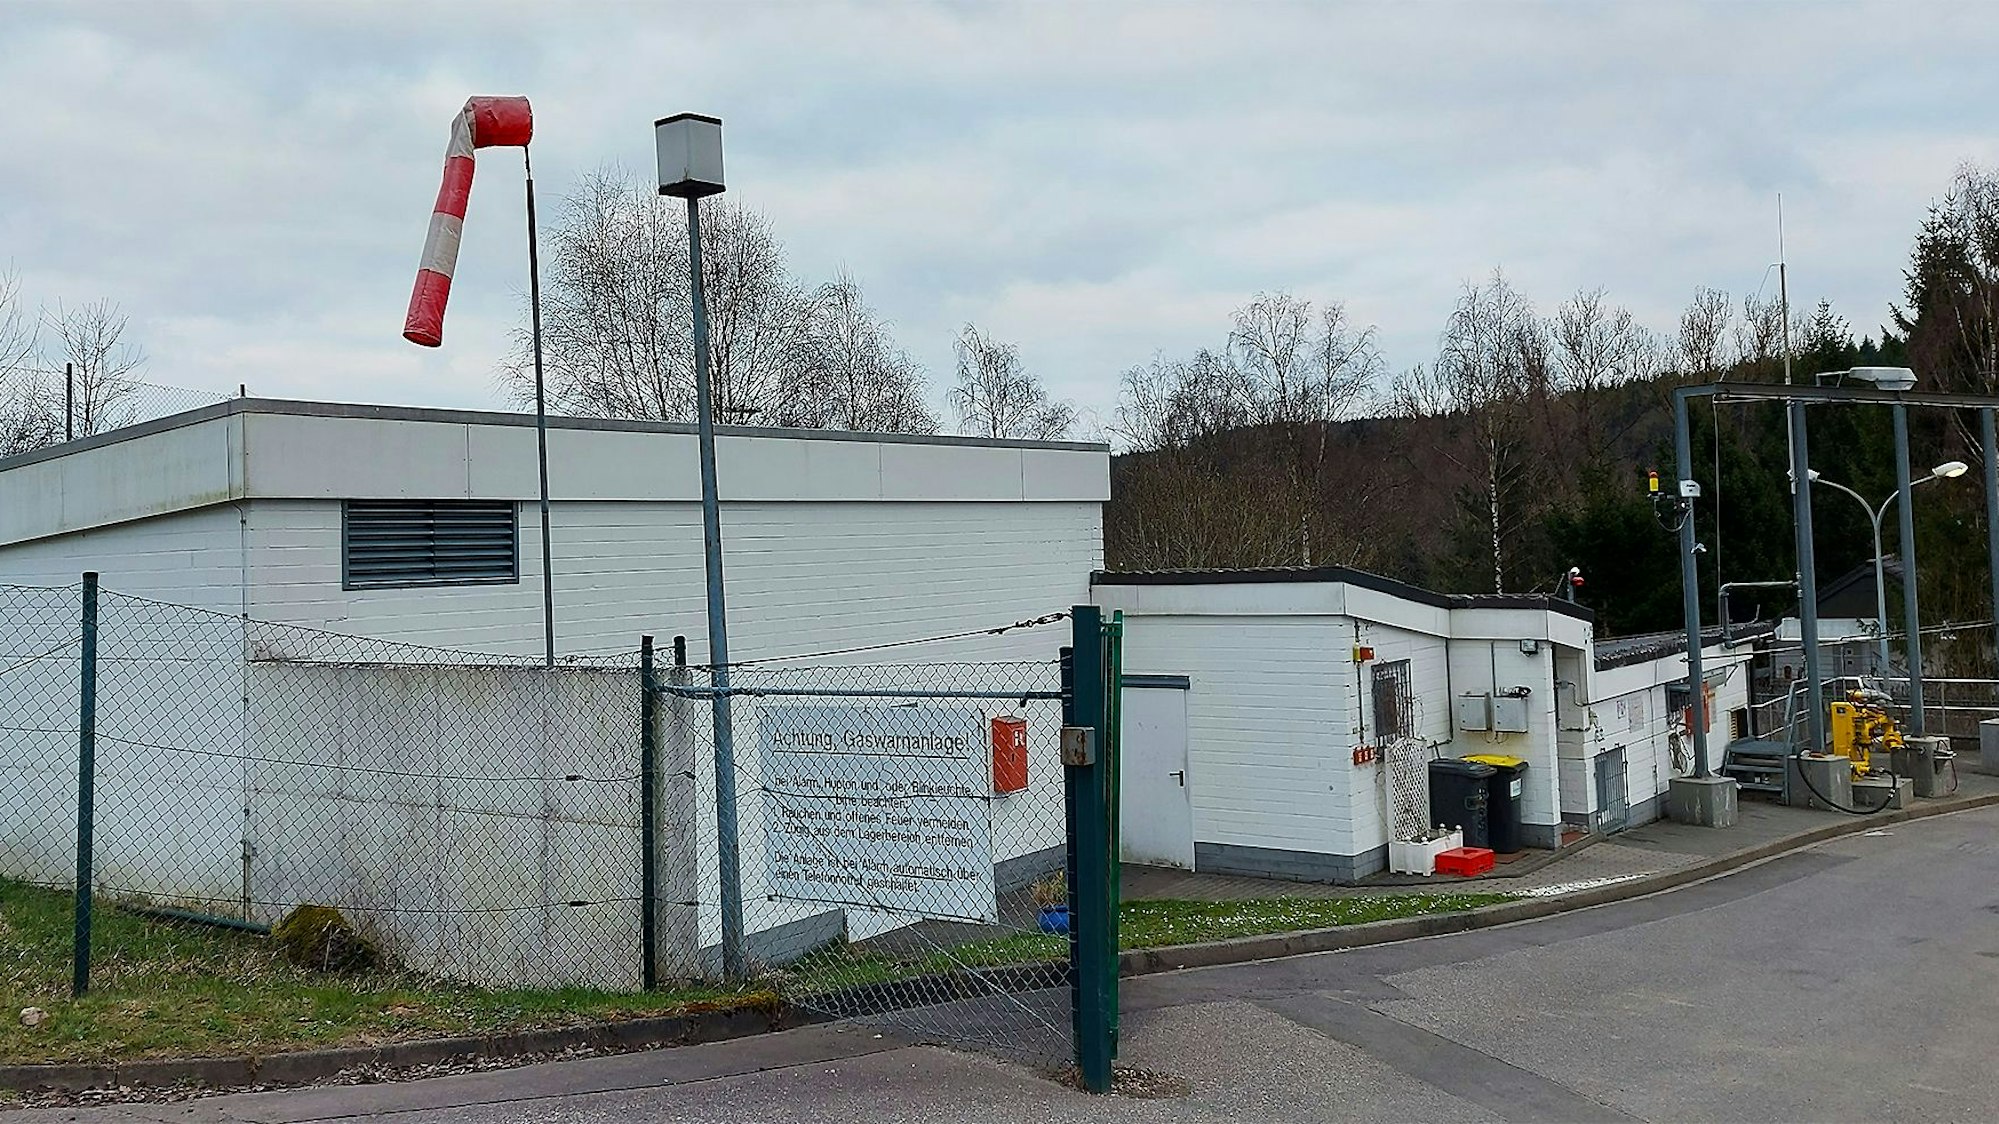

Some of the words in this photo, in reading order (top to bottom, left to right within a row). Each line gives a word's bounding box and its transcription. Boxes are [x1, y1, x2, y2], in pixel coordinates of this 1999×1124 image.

[773, 729, 837, 751] Achtung,
[844, 730, 970, 754] Gaswarnanlage!
[825, 777, 856, 791] Hupton
[861, 780, 878, 791] und
[836, 793, 856, 806] bitte
[782, 807, 820, 820] Rauchen
[825, 811, 842, 821] und
[846, 811, 881, 823] offenes
[886, 813, 912, 825] Feuer
[814, 827, 830, 837] aus
[834, 826, 855, 838] dem
[858, 828, 920, 843] Lagerbereich
[775, 851, 789, 862] Die
[794, 853, 823, 869] Anlage
[827, 856, 840, 868] ist
[843, 856, 858, 869] bei
[893, 863, 953, 878] automatisch
[957, 866, 980, 880] über
[776, 868, 799, 880] einen
